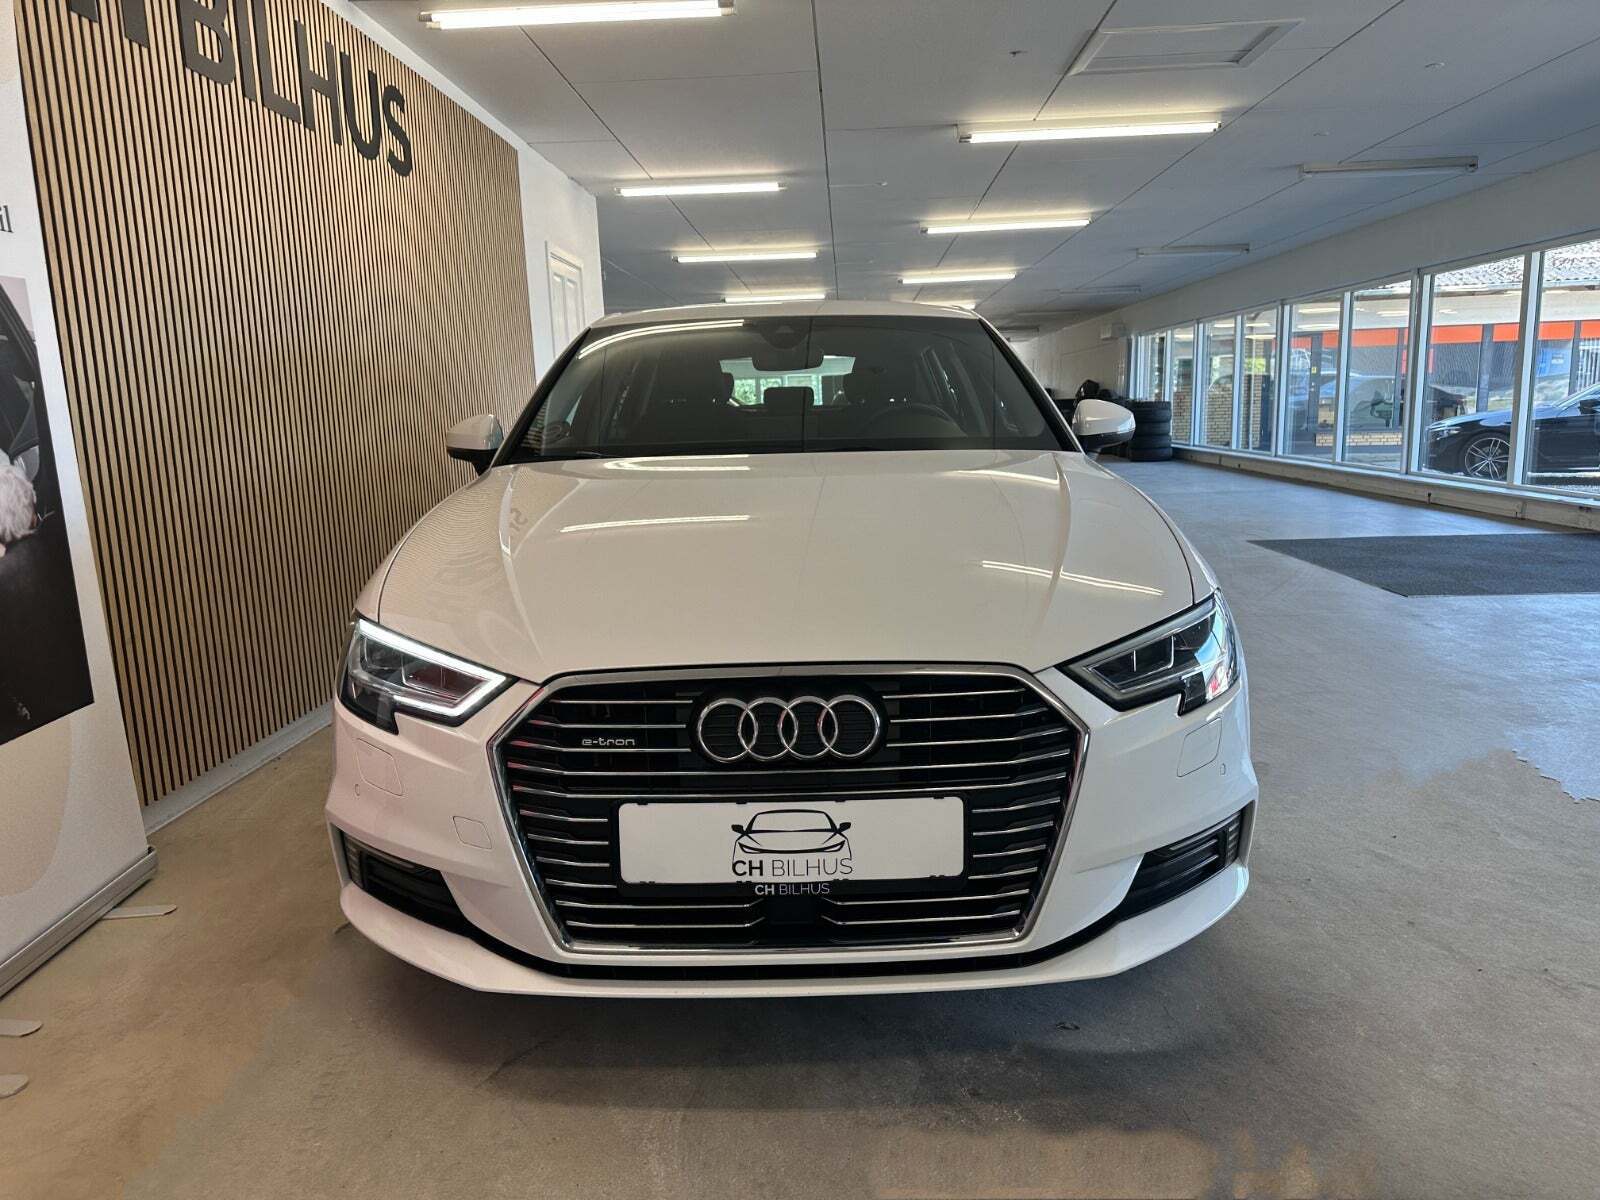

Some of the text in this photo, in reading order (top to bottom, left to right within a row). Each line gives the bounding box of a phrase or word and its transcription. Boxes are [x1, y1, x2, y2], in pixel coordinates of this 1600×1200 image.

[178, 0, 413, 177] BILHUS
[582, 737, 636, 746] e-tron
[732, 858, 853, 877] CH BILHUS
[754, 883, 830, 895] CH BILHUS
